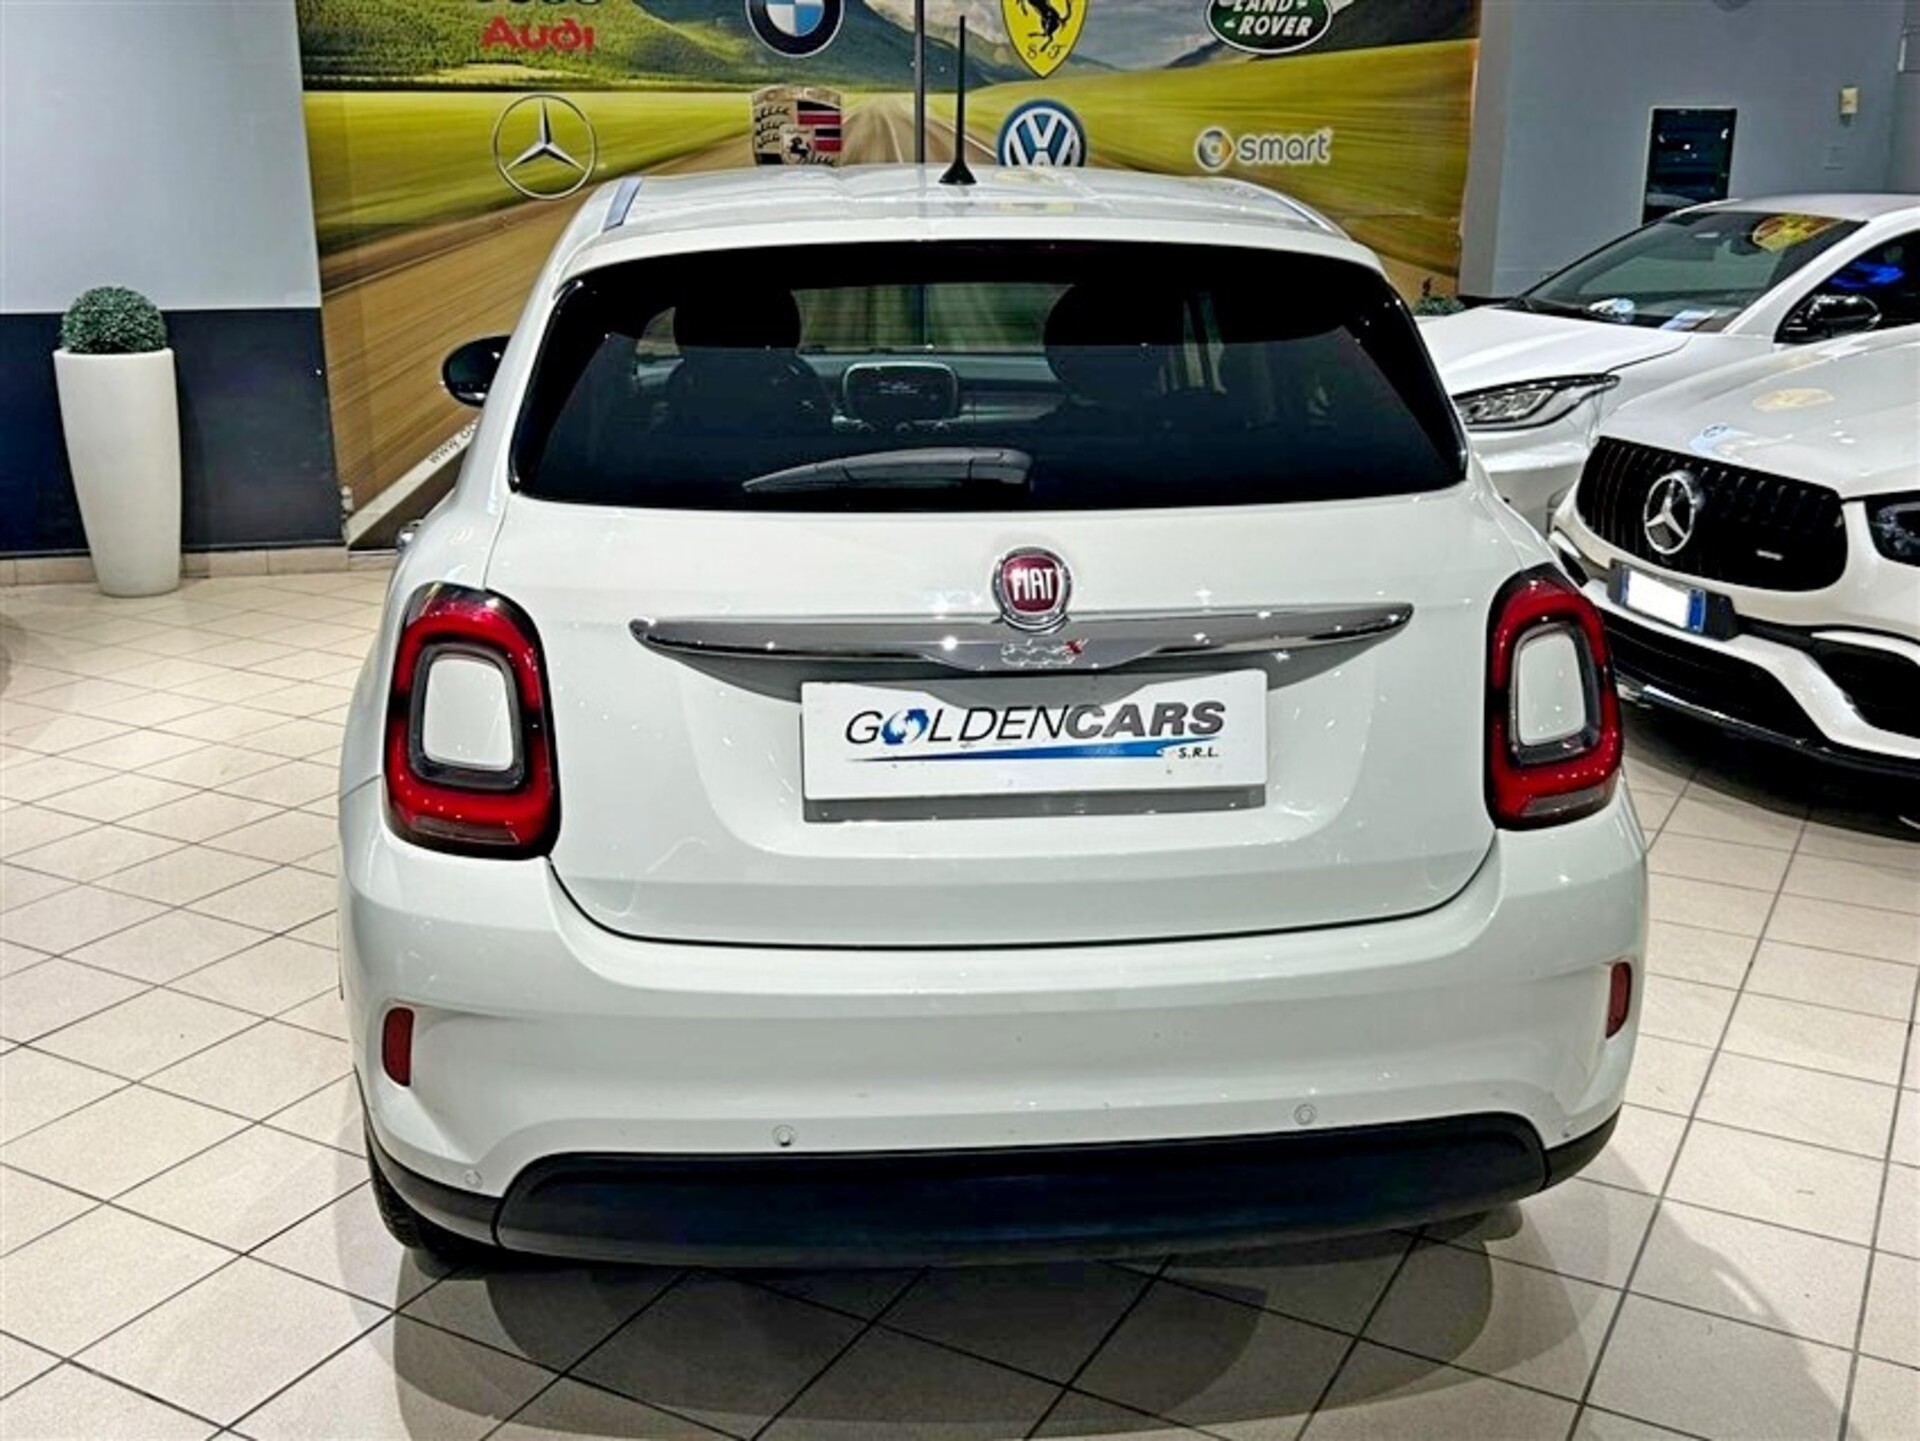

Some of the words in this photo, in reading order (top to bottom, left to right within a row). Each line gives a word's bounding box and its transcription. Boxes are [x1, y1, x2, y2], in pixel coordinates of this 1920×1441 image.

[481, 15, 594, 51] Audi
[1237, 15, 1313, 36] ROVER
[1239, 133, 1328, 162] smart
[1010, 567, 1054, 601] FIAT
[845, 701, 1226, 745] GOLDENCARS
[1178, 746, 1219, 760] S.R.L.
